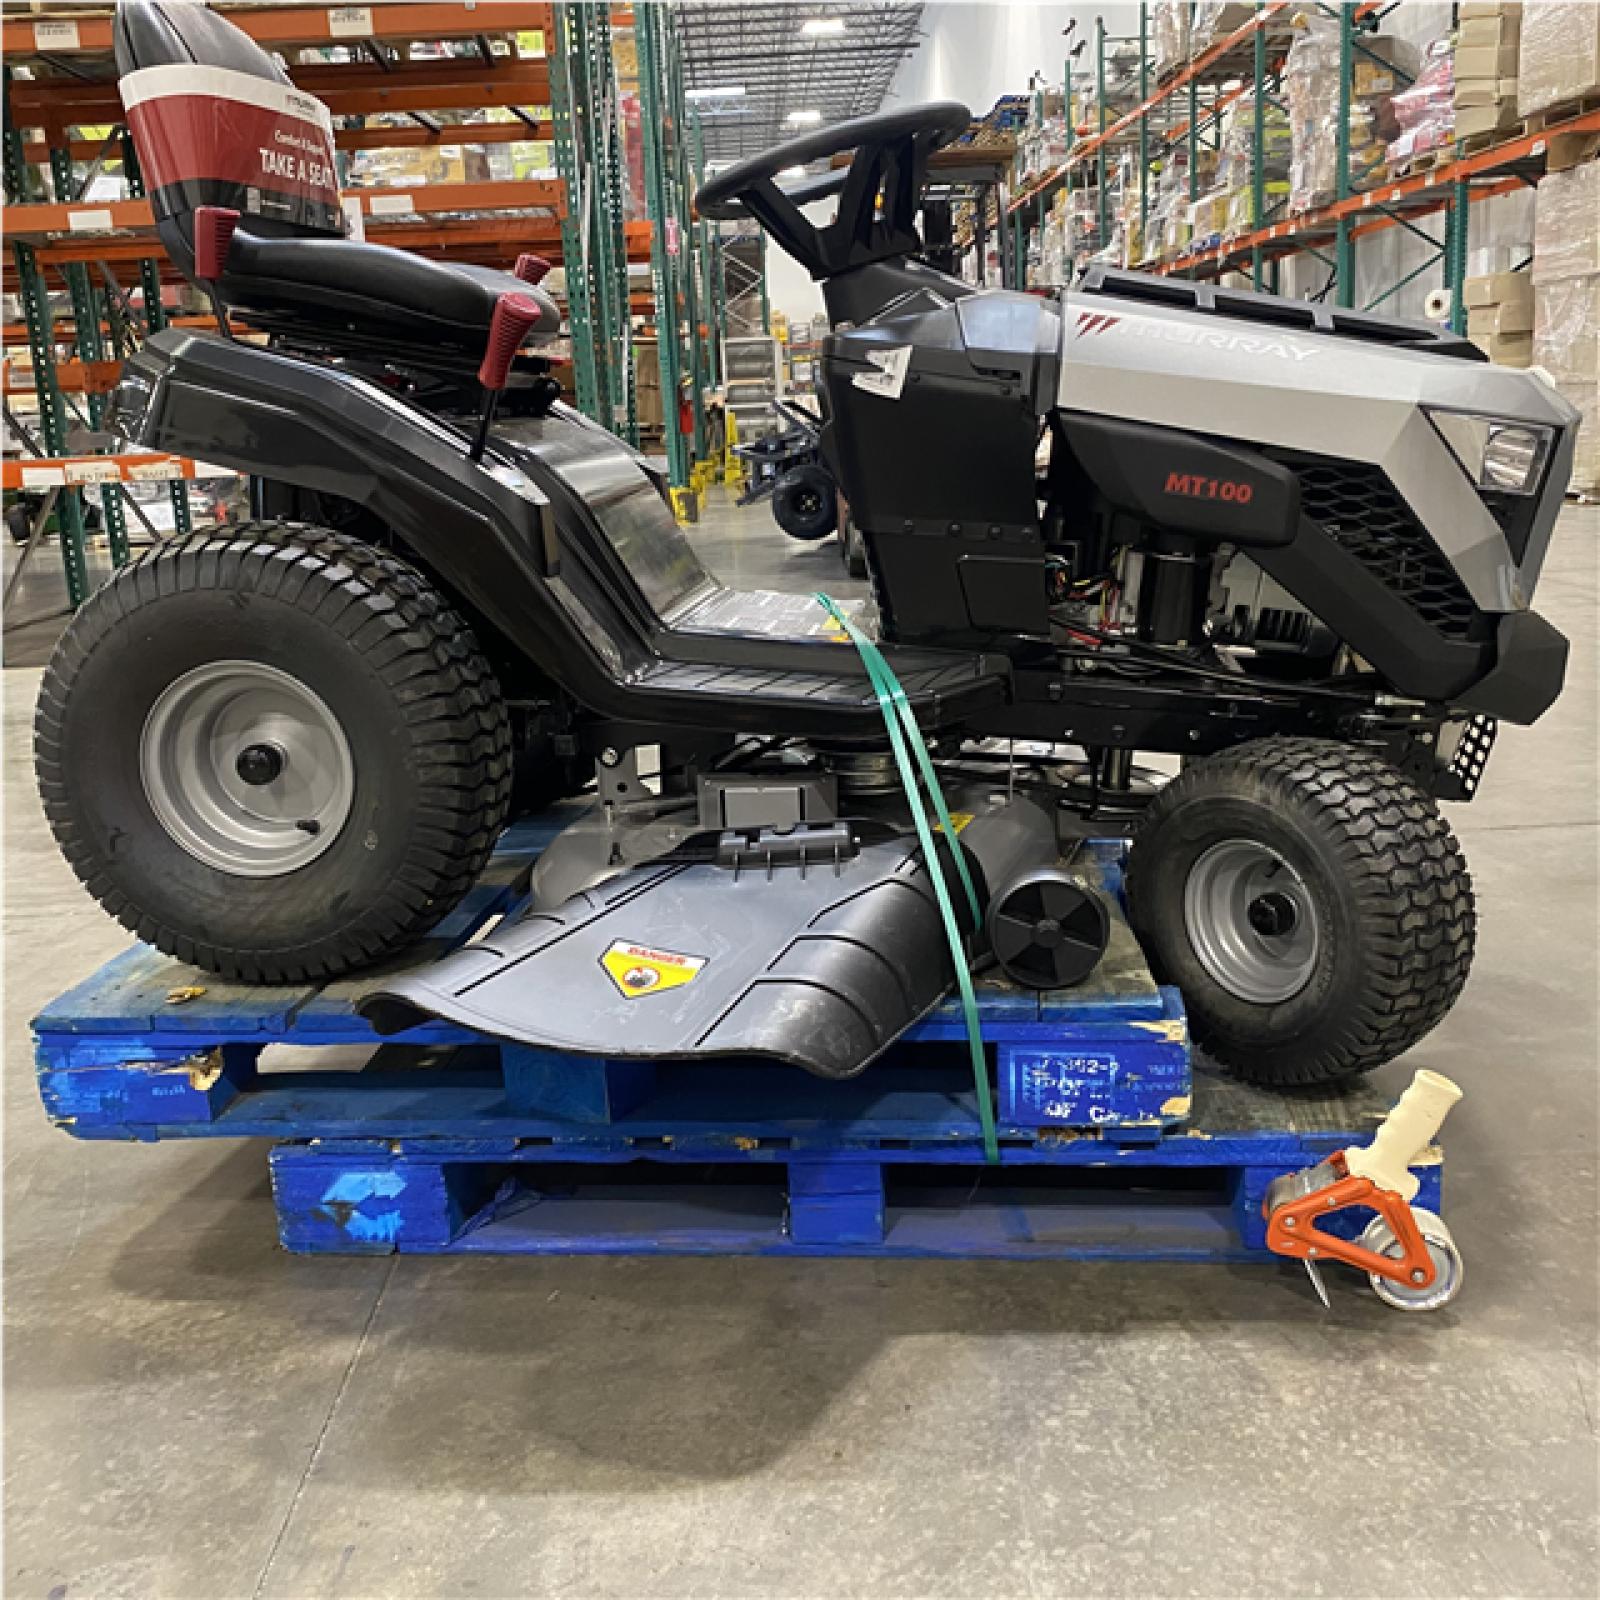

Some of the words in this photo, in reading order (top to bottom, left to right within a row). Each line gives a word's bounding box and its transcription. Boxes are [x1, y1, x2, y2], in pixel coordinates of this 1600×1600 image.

[259, 147, 295, 178] TAKE
[297, 159, 306, 181] A
[309, 162, 335, 190] SEA
[1119, 322, 1320, 360] MURRAY
[1164, 471, 1253, 503] MT100
[628, 947, 686, 965] DANGER
